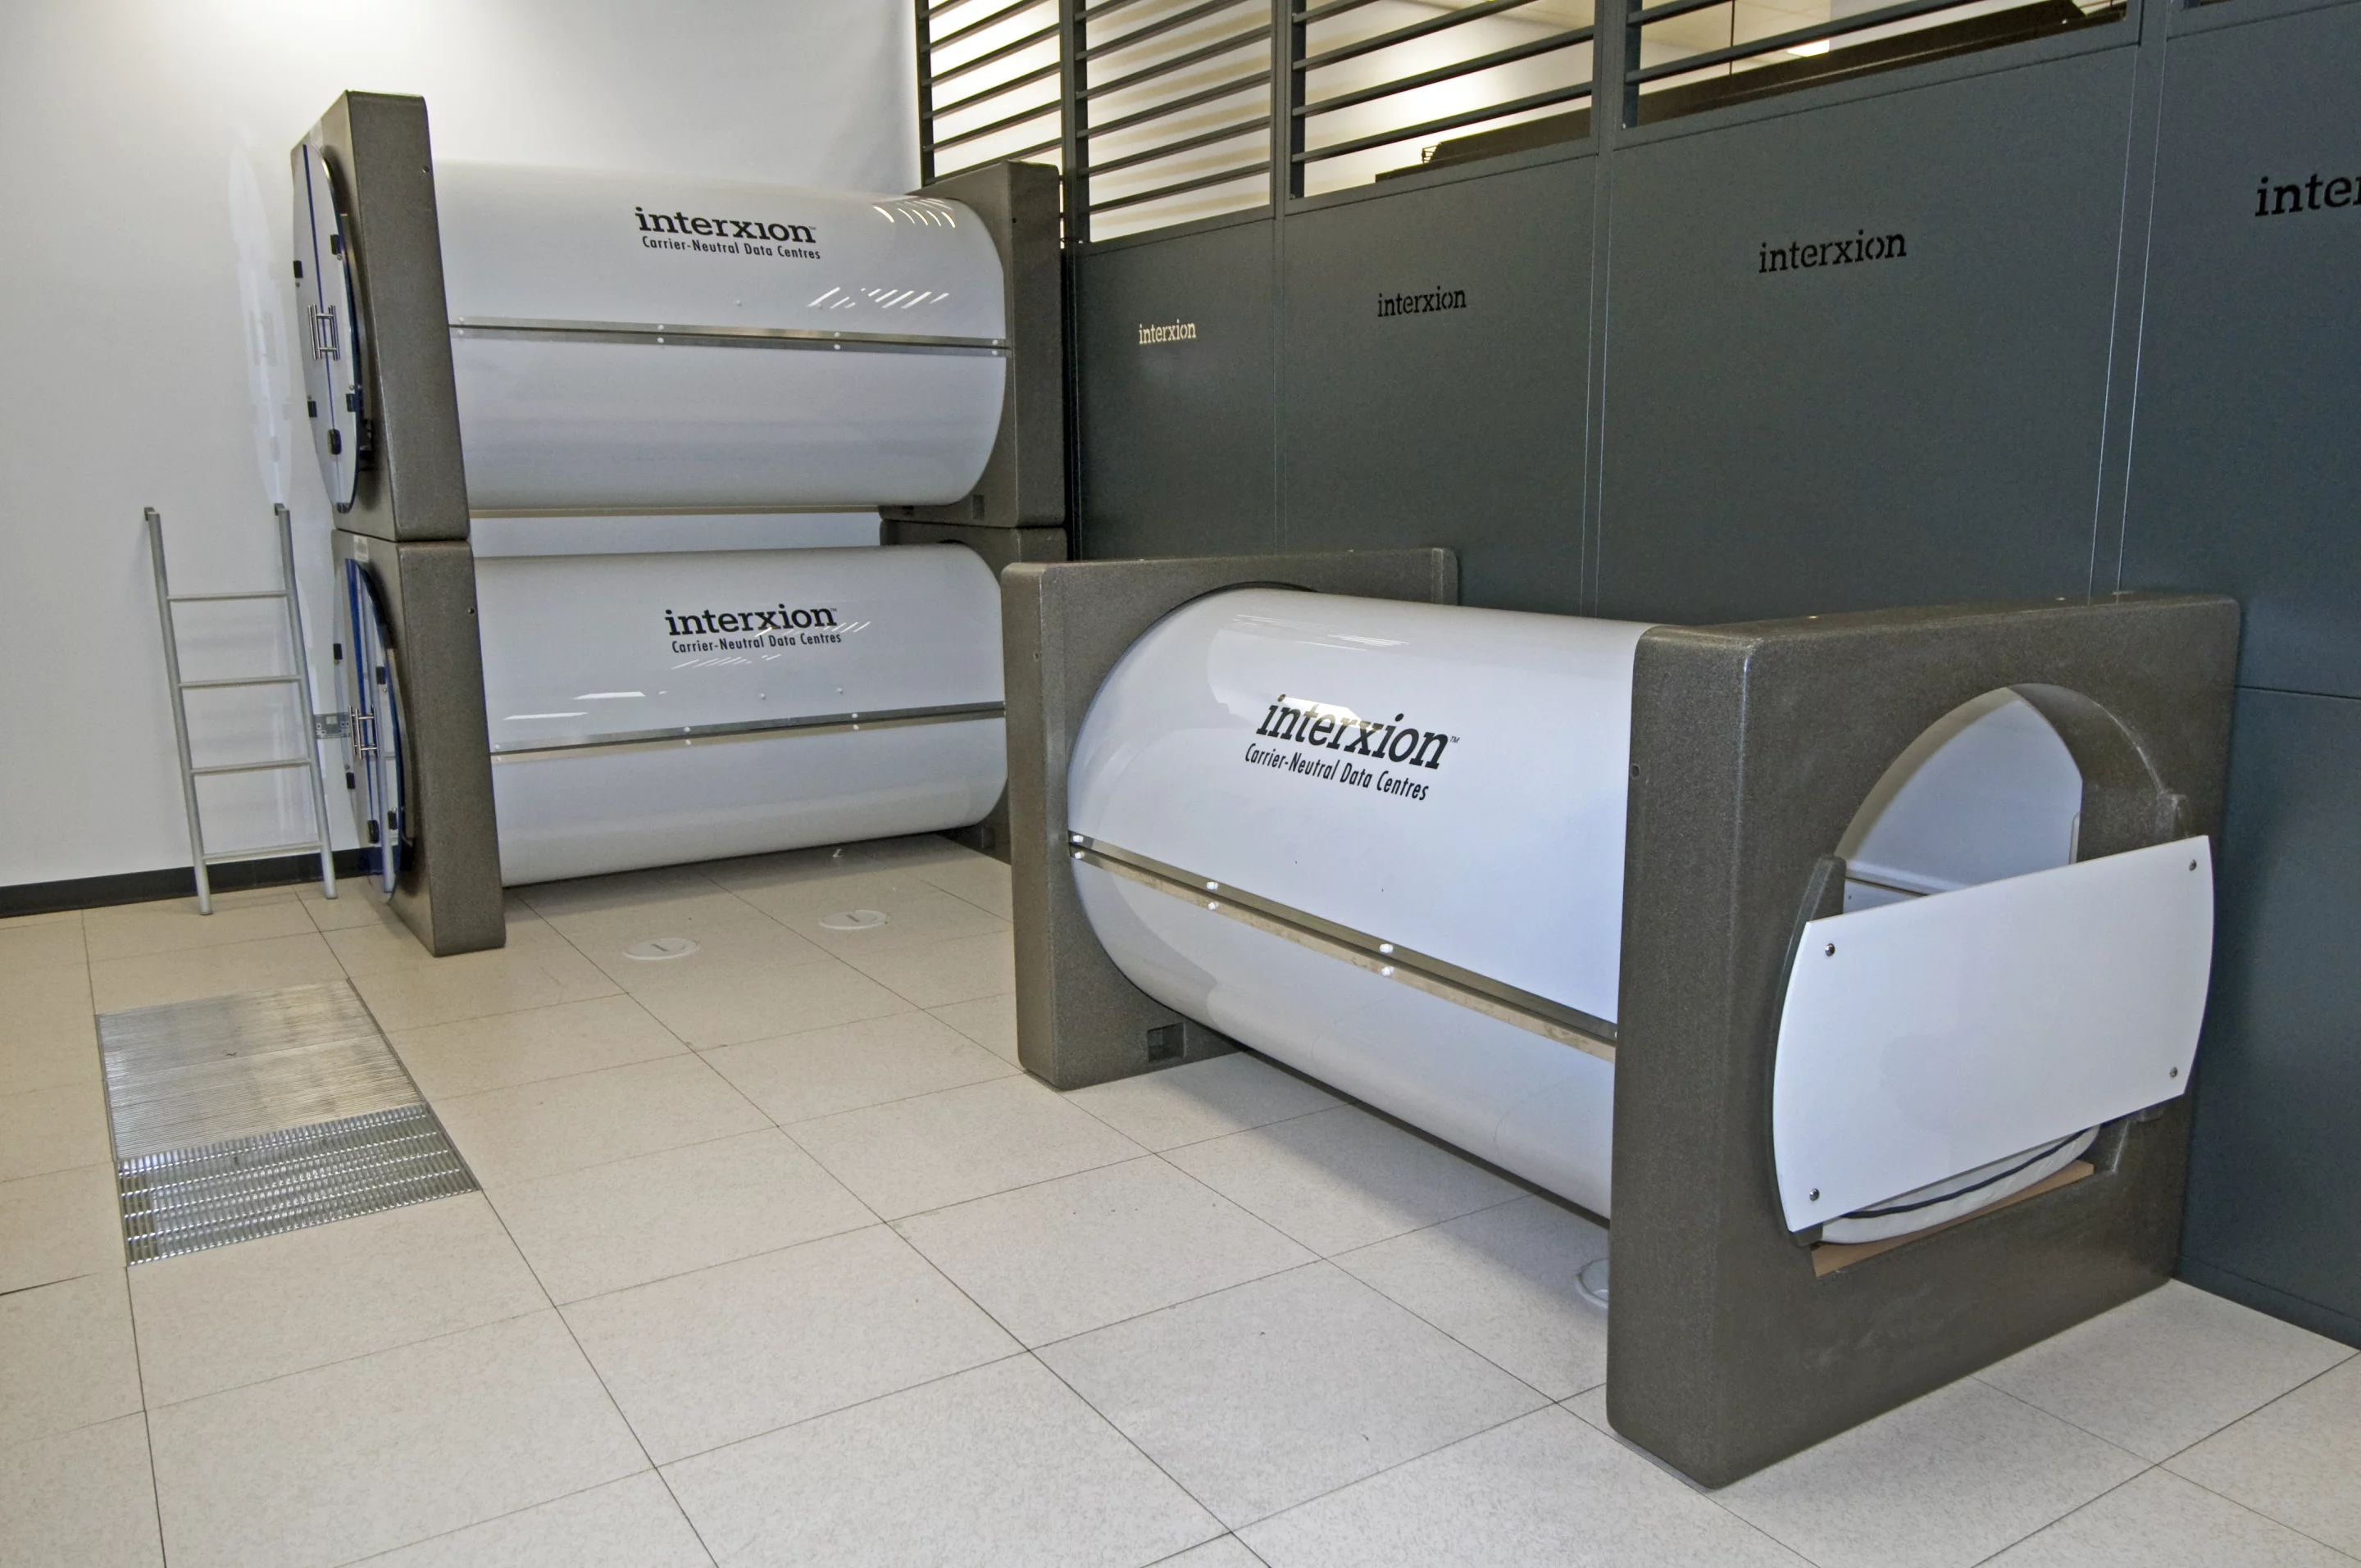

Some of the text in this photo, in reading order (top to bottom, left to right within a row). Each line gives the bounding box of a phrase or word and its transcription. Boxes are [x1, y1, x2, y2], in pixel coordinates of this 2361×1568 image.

[642, 236, 821, 260] Carrier-Neutral Data Centres
[1758, 229, 1908, 274] interxion
[1377, 285, 1467, 317] interxion
[1139, 319, 1197, 345] interxion
[671, 632, 842, 653] Carrier-Neutral Data Centres
[1245, 743, 1430, 801] Carrier-Neutral Data Centres
